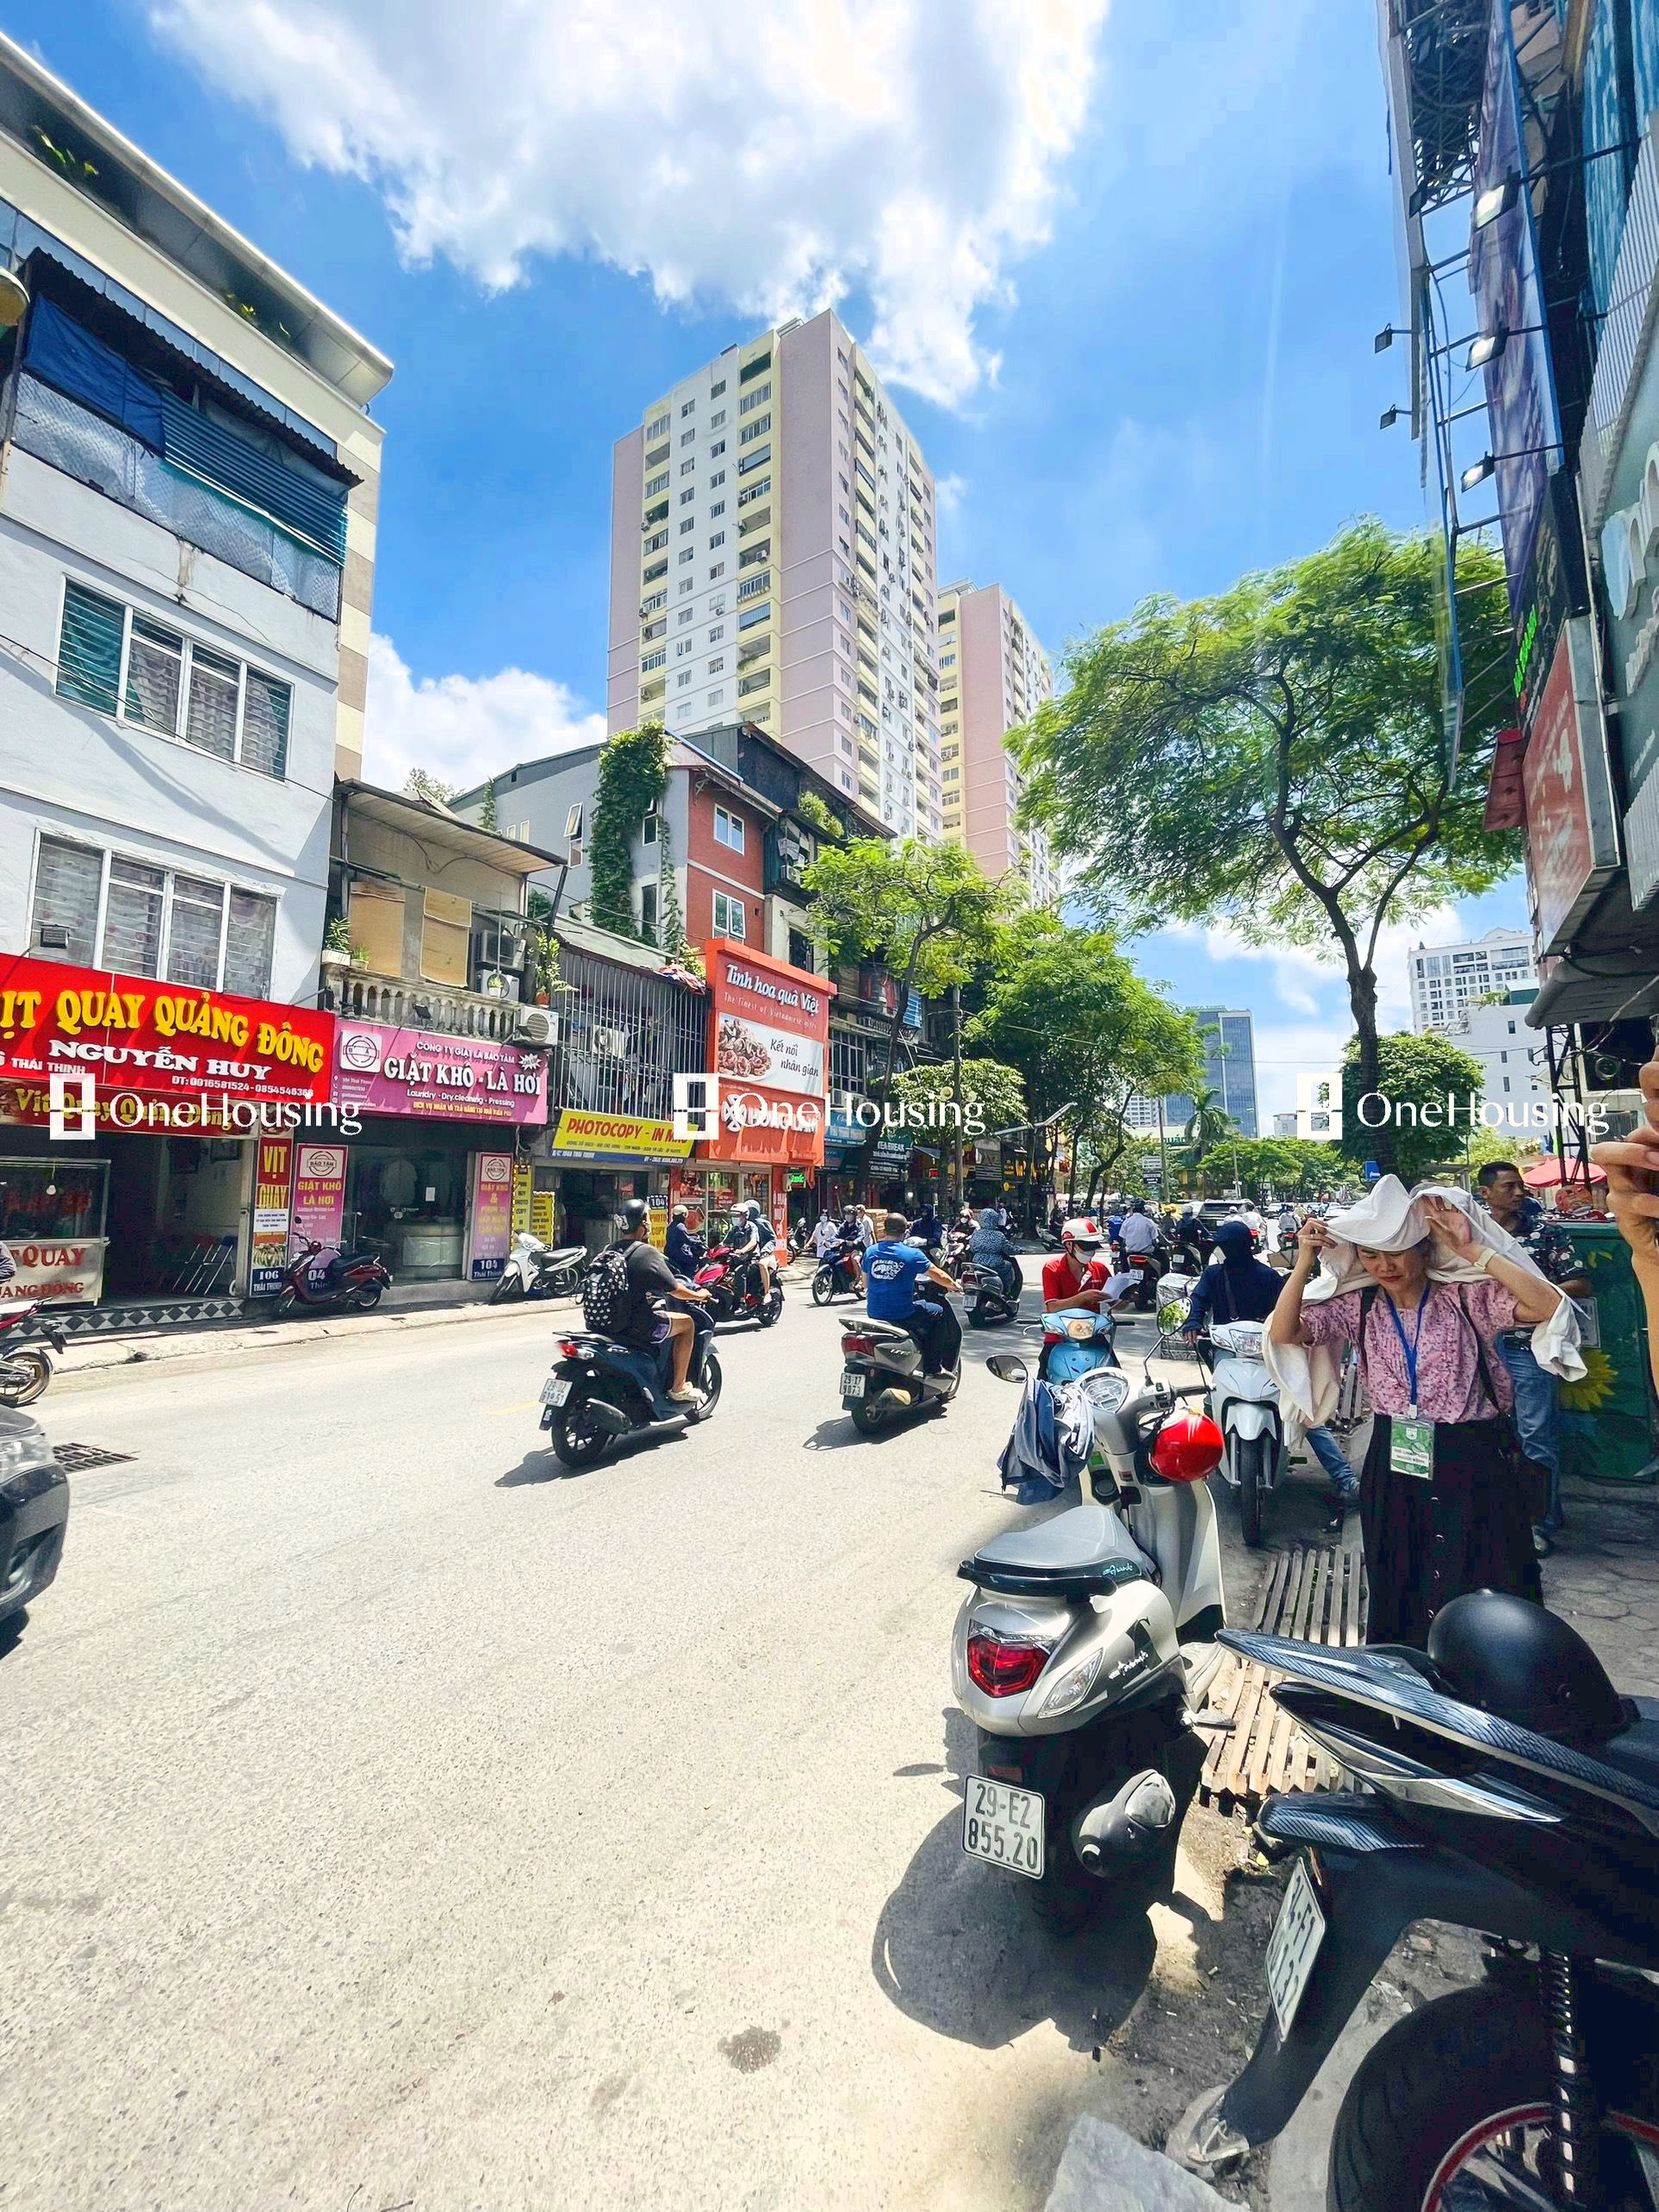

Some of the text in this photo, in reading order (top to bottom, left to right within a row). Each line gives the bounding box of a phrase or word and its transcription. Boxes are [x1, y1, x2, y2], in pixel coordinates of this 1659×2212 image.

[726, 963, 820, 1017] Tinh hoa quà Việt
[0, 990, 324, 1074] ỊT QUAY QUẢNG ĐÔNG
[416, 1041, 443, 1053] CÔNG
[444, 1044, 454, 1054] TY
[770, 1037, 799, 1057] Kết nối
[11, 1056, 43, 1070] THÁI
[49, 1039, 273, 1081] NGUYỄN HUY
[781, 1059, 820, 1078] nhân gian
[383, 1053, 432, 1086] GIẶT
[436, 1061, 474, 1087] KHÔ
[487, 1065, 510, 1091] LÀ
[513, 1073, 541, 1096] HƠI
[407, 1088, 437, 1100] Laundry
[488, 1097, 516, 1108] Pressing
[566, 1118, 643, 1139] PHOTOCOPY
[651, 1127, 665, 1142] IN
[263, 1145, 288, 1179] VỊT
[259, 1185, 287, 1208] QUAY
[298, 1180, 342, 1193] GIẶT KHÔ
[303, 1194, 335, 1205] LÀ HƠI
[490, 1193, 498, 1203] &
[651, 1198, 665, 1207] 104
[22, 1245, 87, 1268] QUAY
[480, 1260, 498, 1270] 104
[259, 1271, 279, 1281] 106
[307, 1269, 326, 1281] 04
[968, 1818, 1037, 1870] 855.20
